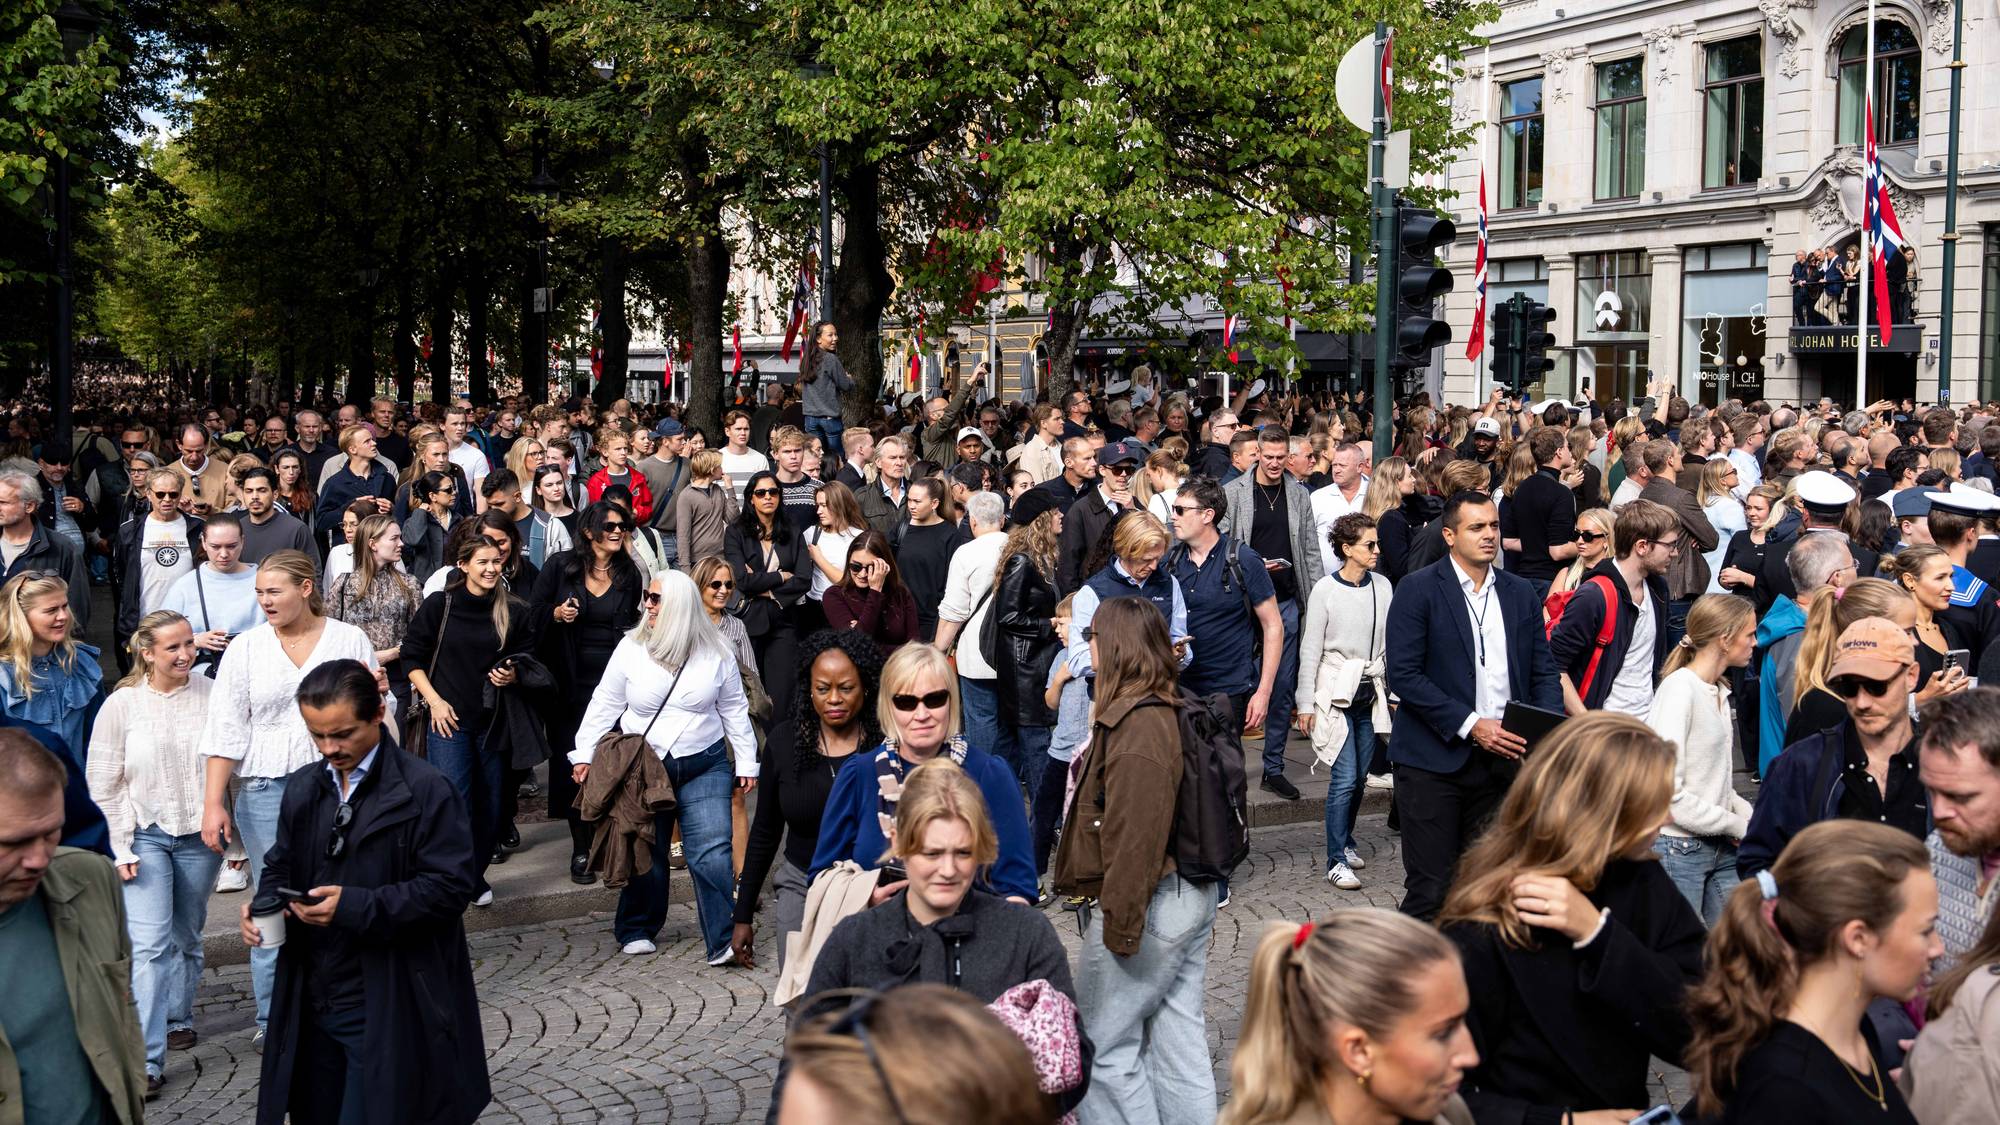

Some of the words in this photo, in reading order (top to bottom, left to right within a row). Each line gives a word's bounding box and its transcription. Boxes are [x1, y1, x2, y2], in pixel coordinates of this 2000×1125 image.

[1800, 335, 1834, 348] JOHAN
[1841, 335, 1888, 348] HOEL
[1741, 372, 1755, 383] CH
